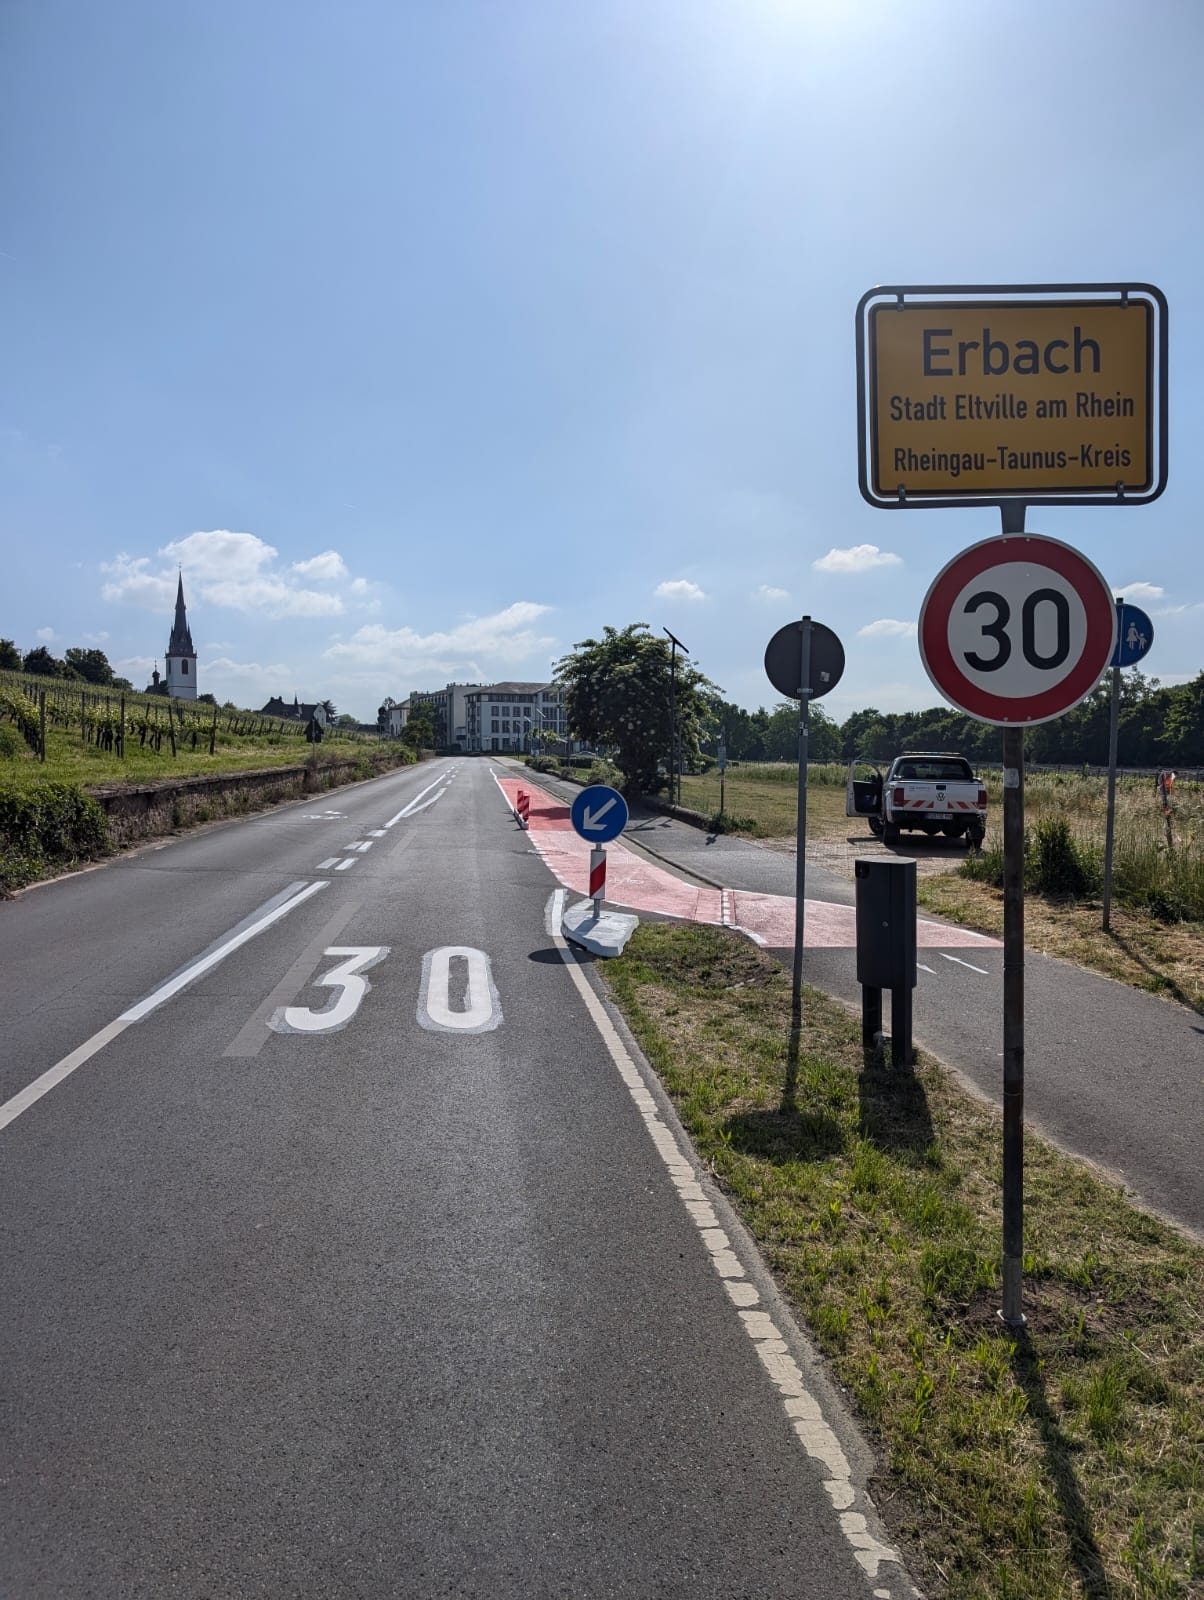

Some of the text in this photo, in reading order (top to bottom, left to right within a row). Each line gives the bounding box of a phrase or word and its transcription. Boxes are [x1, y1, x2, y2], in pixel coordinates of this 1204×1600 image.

[923, 326, 1101, 376] Erbach
[890, 392, 1135, 421] Stadt Eltville am Rhein
[894, 444, 1131, 477] Rheingau-Taunus-Kreis
[963, 588, 1070, 672] 30
[285, 946, 494, 1031] 30
